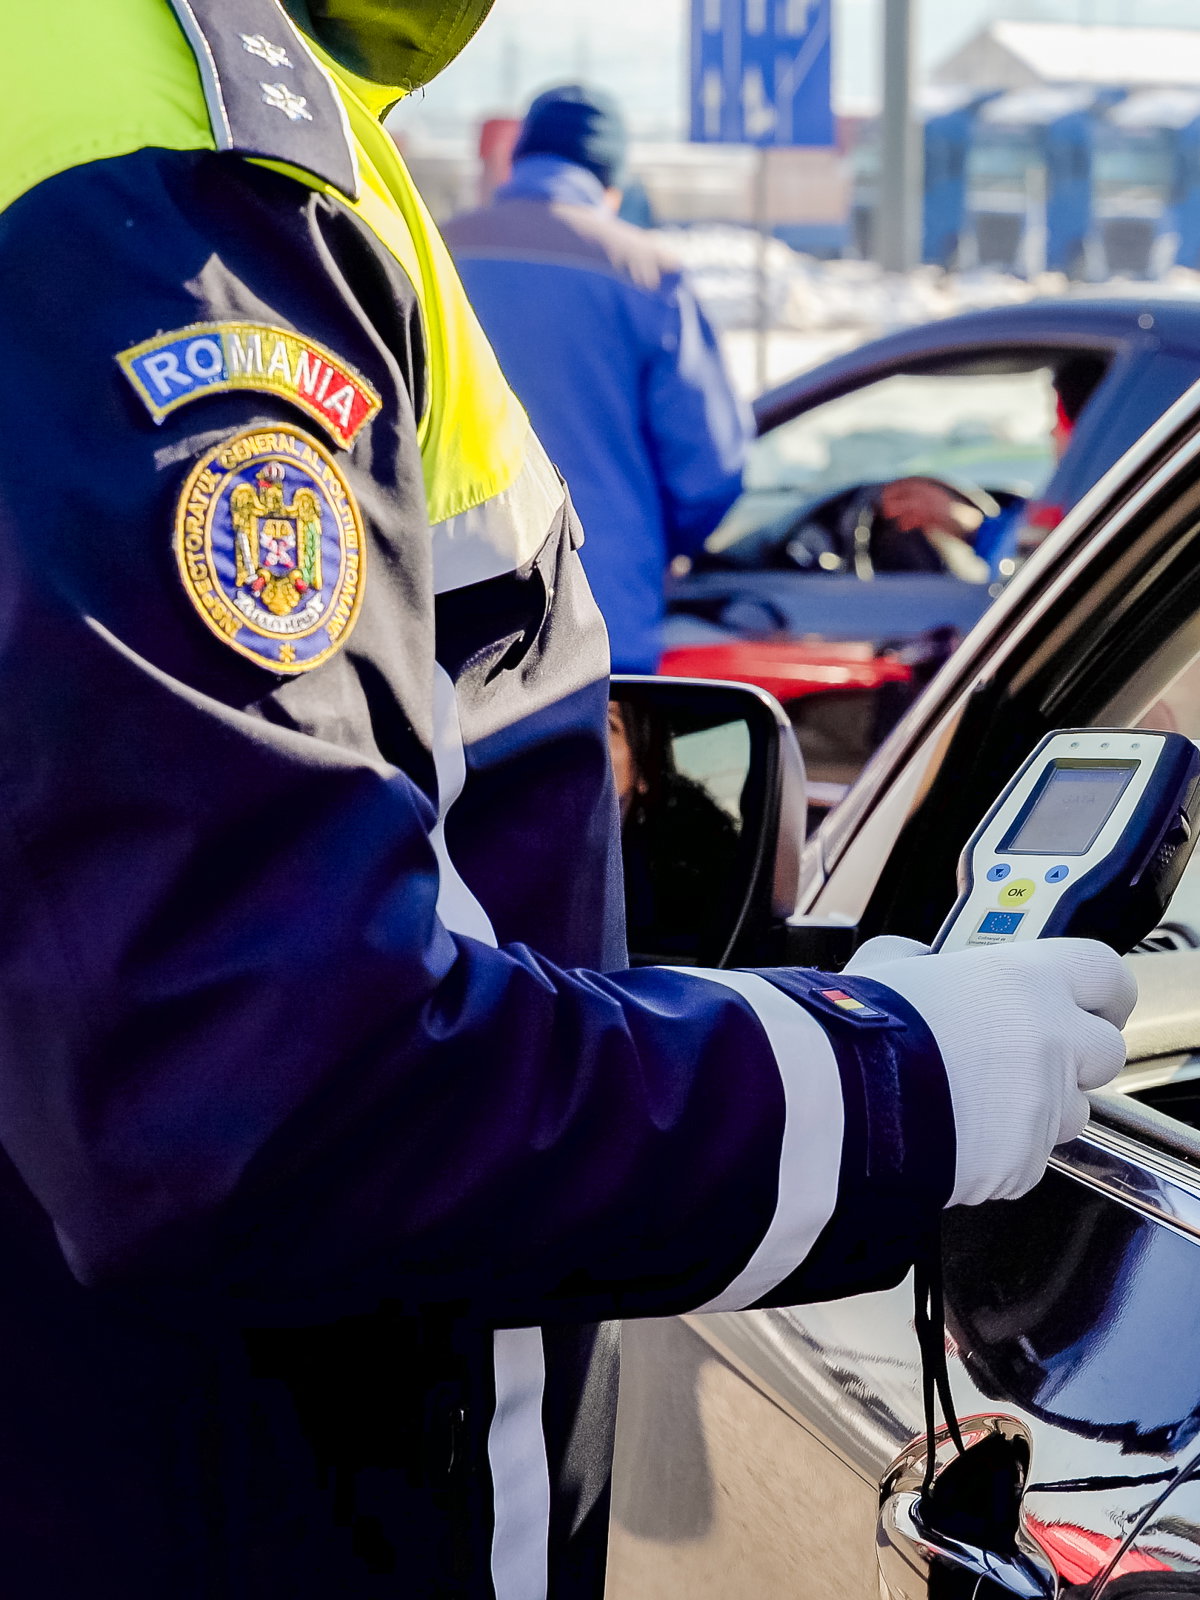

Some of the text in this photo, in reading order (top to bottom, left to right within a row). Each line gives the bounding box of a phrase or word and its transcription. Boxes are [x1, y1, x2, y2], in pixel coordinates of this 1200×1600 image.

[142, 333, 356, 427] ROMANIA
[221, 433, 300, 469] GENERAL
[1007, 888, 1027, 897] OK
